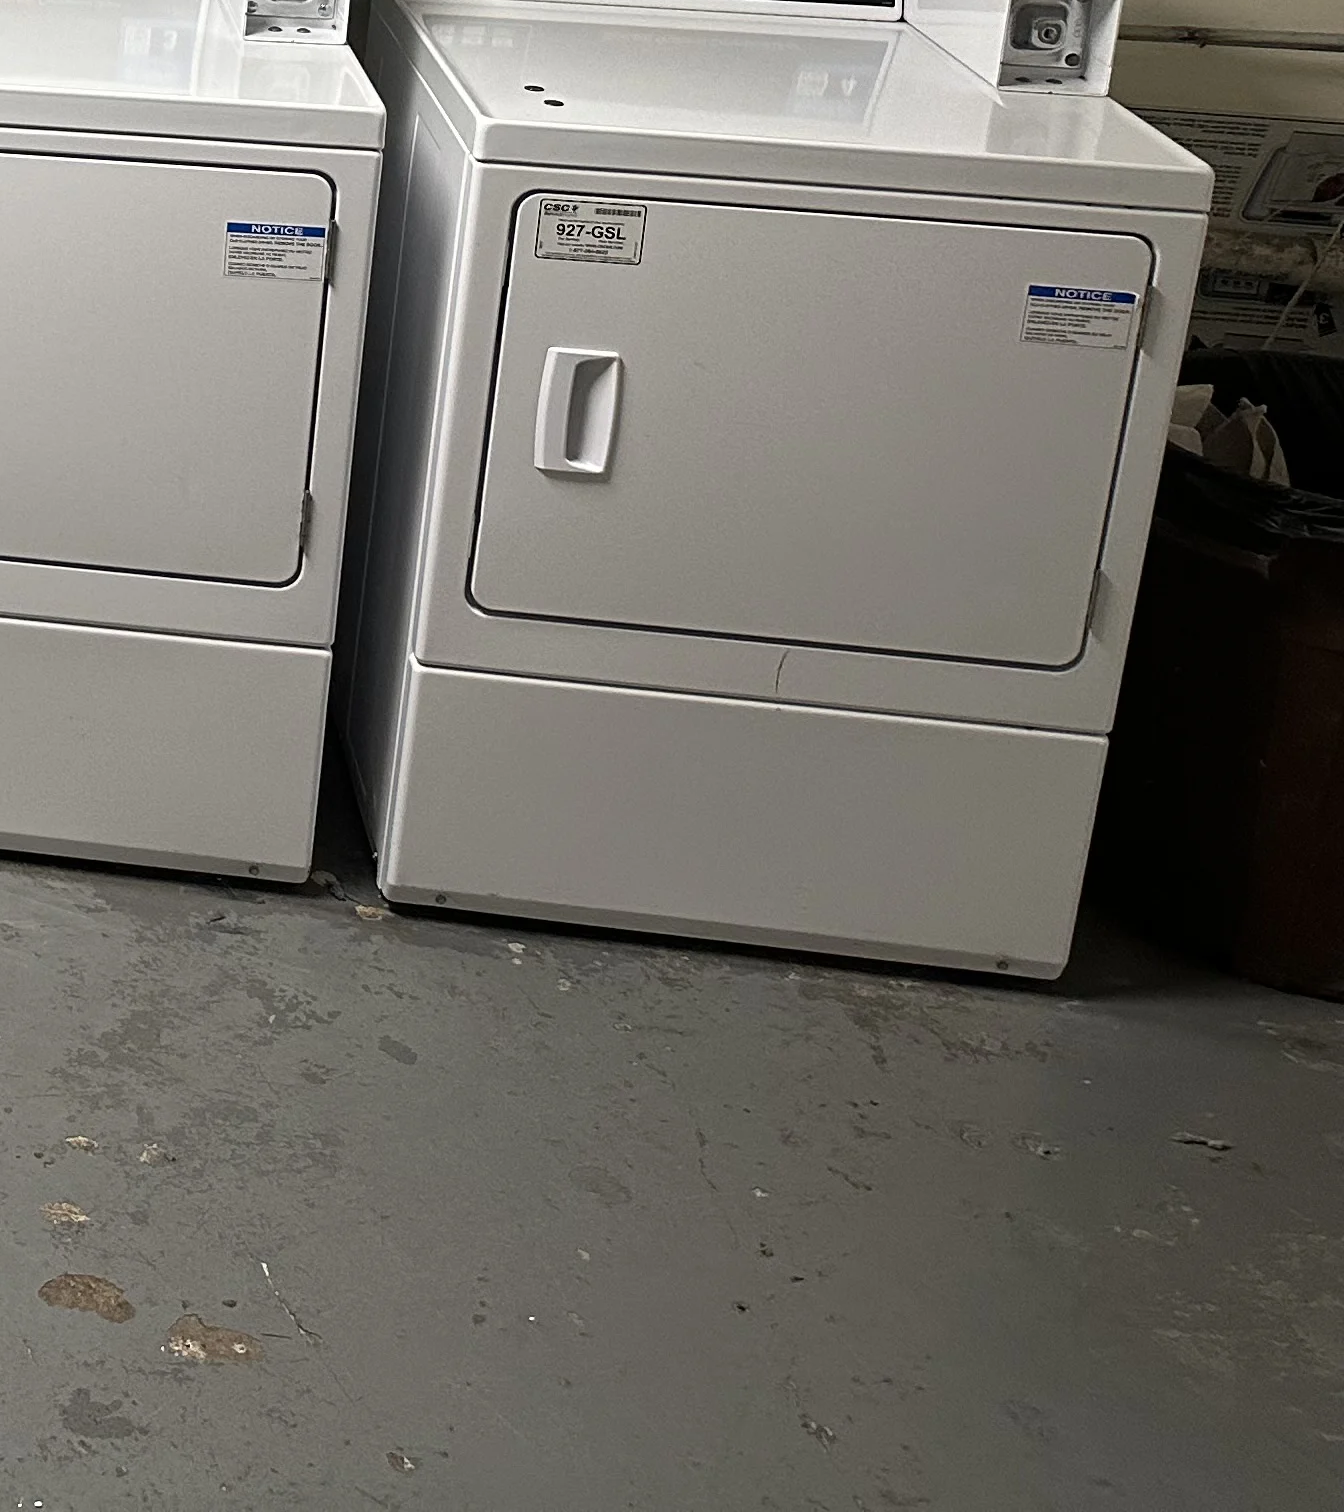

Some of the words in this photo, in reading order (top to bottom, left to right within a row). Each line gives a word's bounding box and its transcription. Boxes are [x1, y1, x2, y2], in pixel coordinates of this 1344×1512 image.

[544, 203, 570, 212] CSC
[251, 225, 304, 236] NOTICE
[556, 223, 626, 240] 927-GSL
[1055, 288, 1113, 301] NOTICE
